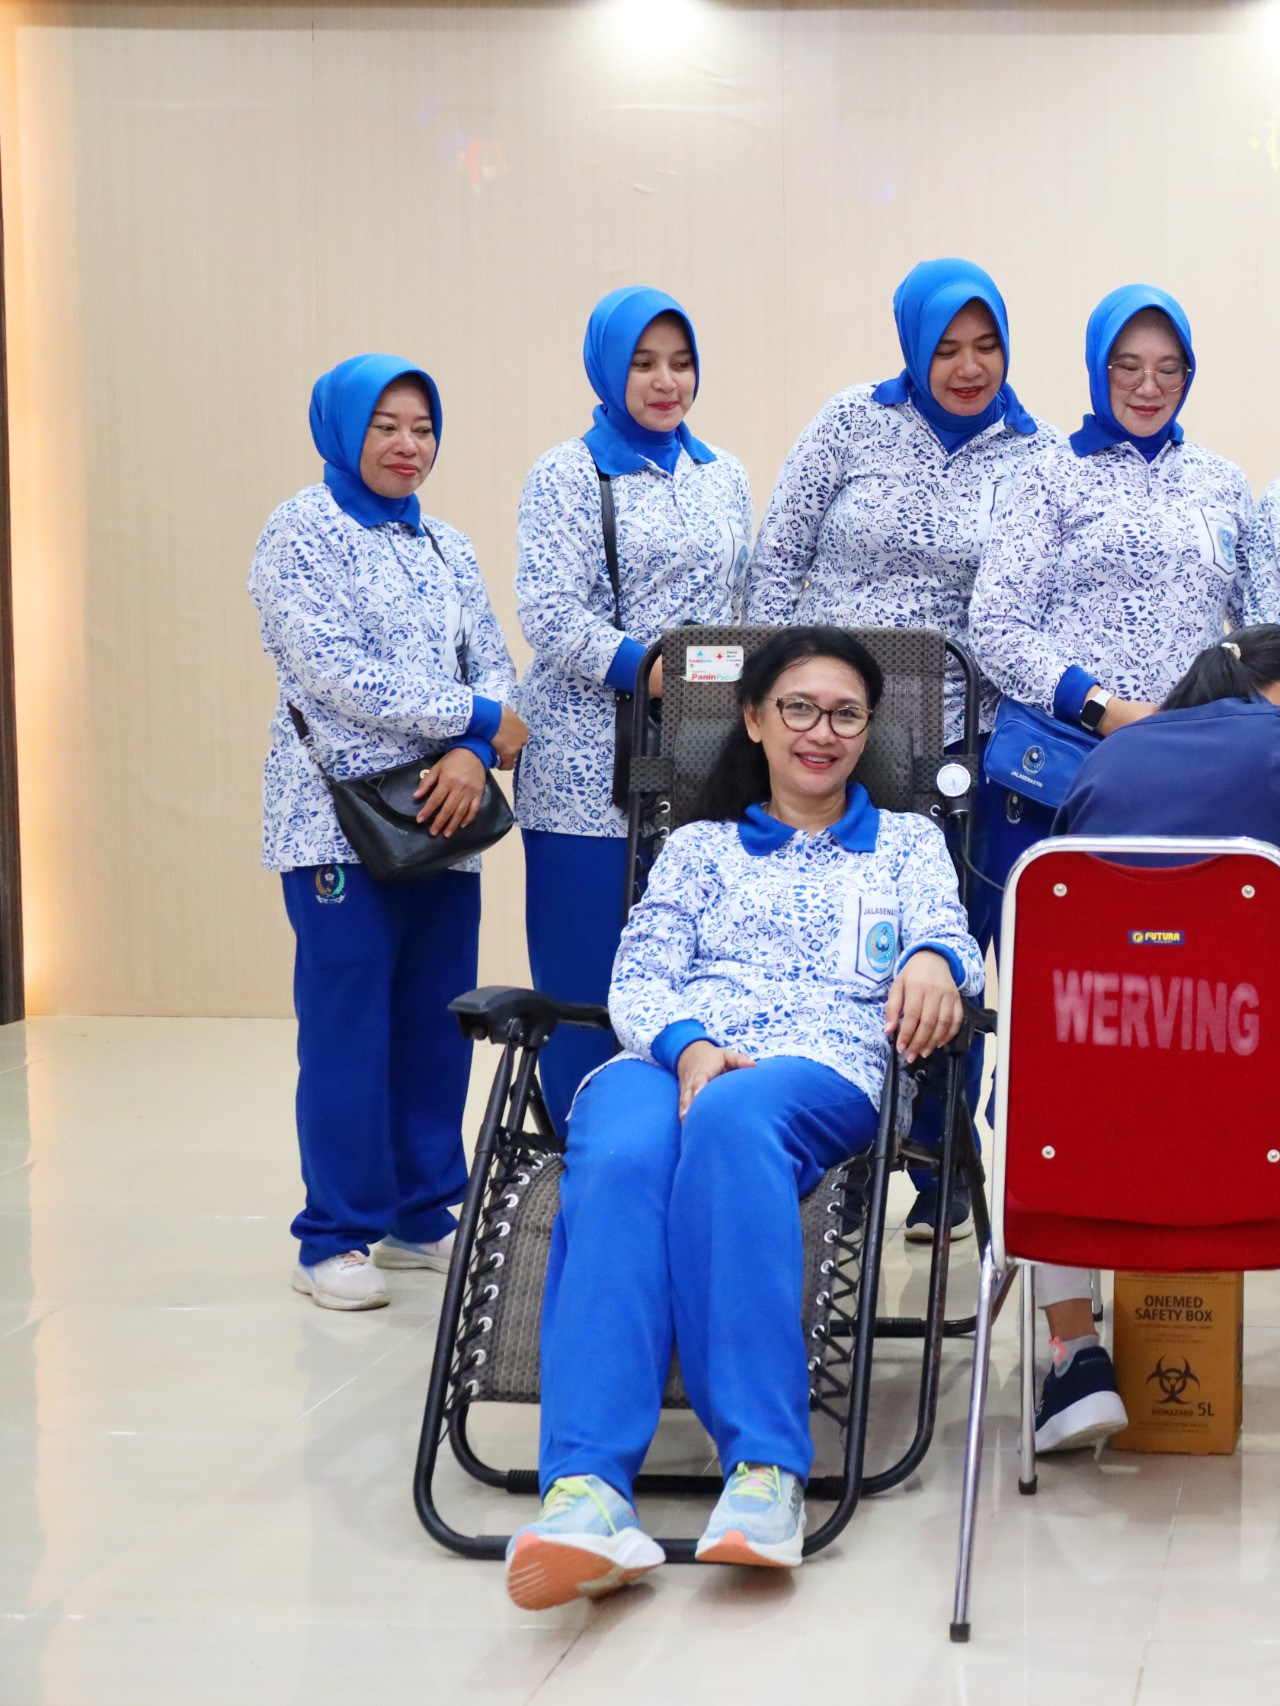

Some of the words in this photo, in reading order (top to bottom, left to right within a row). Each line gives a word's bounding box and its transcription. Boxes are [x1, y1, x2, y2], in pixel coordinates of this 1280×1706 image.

[1144, 931, 1180, 942] FUTURA
[1052, 968, 1260, 1056] WERVING
[1144, 1295, 1203, 1309] ONEMED
[1134, 1308, 1182, 1322] SAFETY
[1185, 1309, 1213, 1322] BOX
[1151, 1408, 1194, 1417] BIOHAZARD
[1198, 1402, 1215, 1417] 5L
